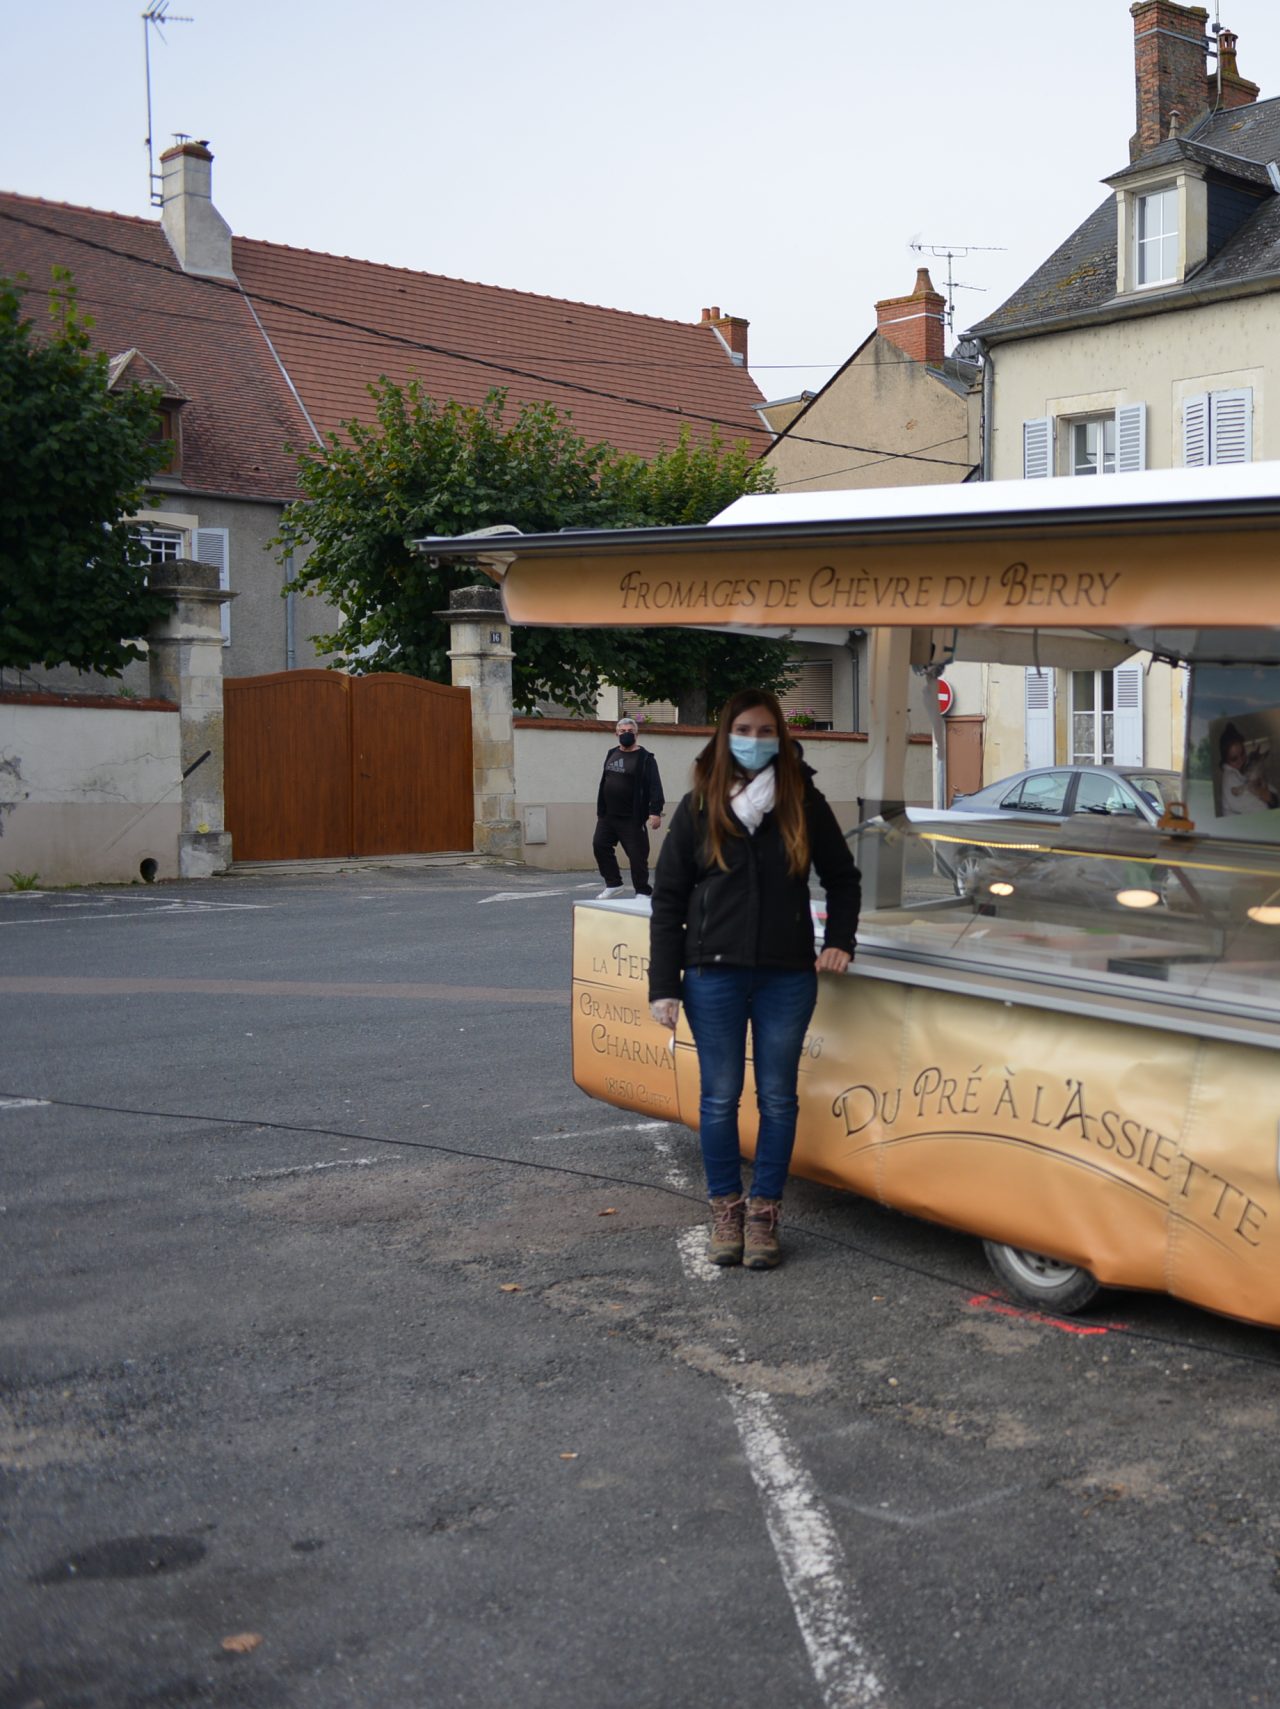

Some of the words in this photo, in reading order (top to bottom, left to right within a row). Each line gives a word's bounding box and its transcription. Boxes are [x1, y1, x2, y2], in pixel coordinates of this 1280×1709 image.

[619, 570, 761, 609] FROMAGES
[764, 578, 801, 608] DE
[807, 565, 933, 609] CHÈVRE
[939, 575, 991, 608] DU
[999, 560, 1122, 608] BERRY
[592, 956, 608, 974] LA
[612, 943, 651, 981] FER
[579, 992, 642, 1027] GRANDE
[831, 1084, 902, 1137] DU
[913, 1064, 984, 1118] PRÉ
[993, 1065, 1019, 1119] À
